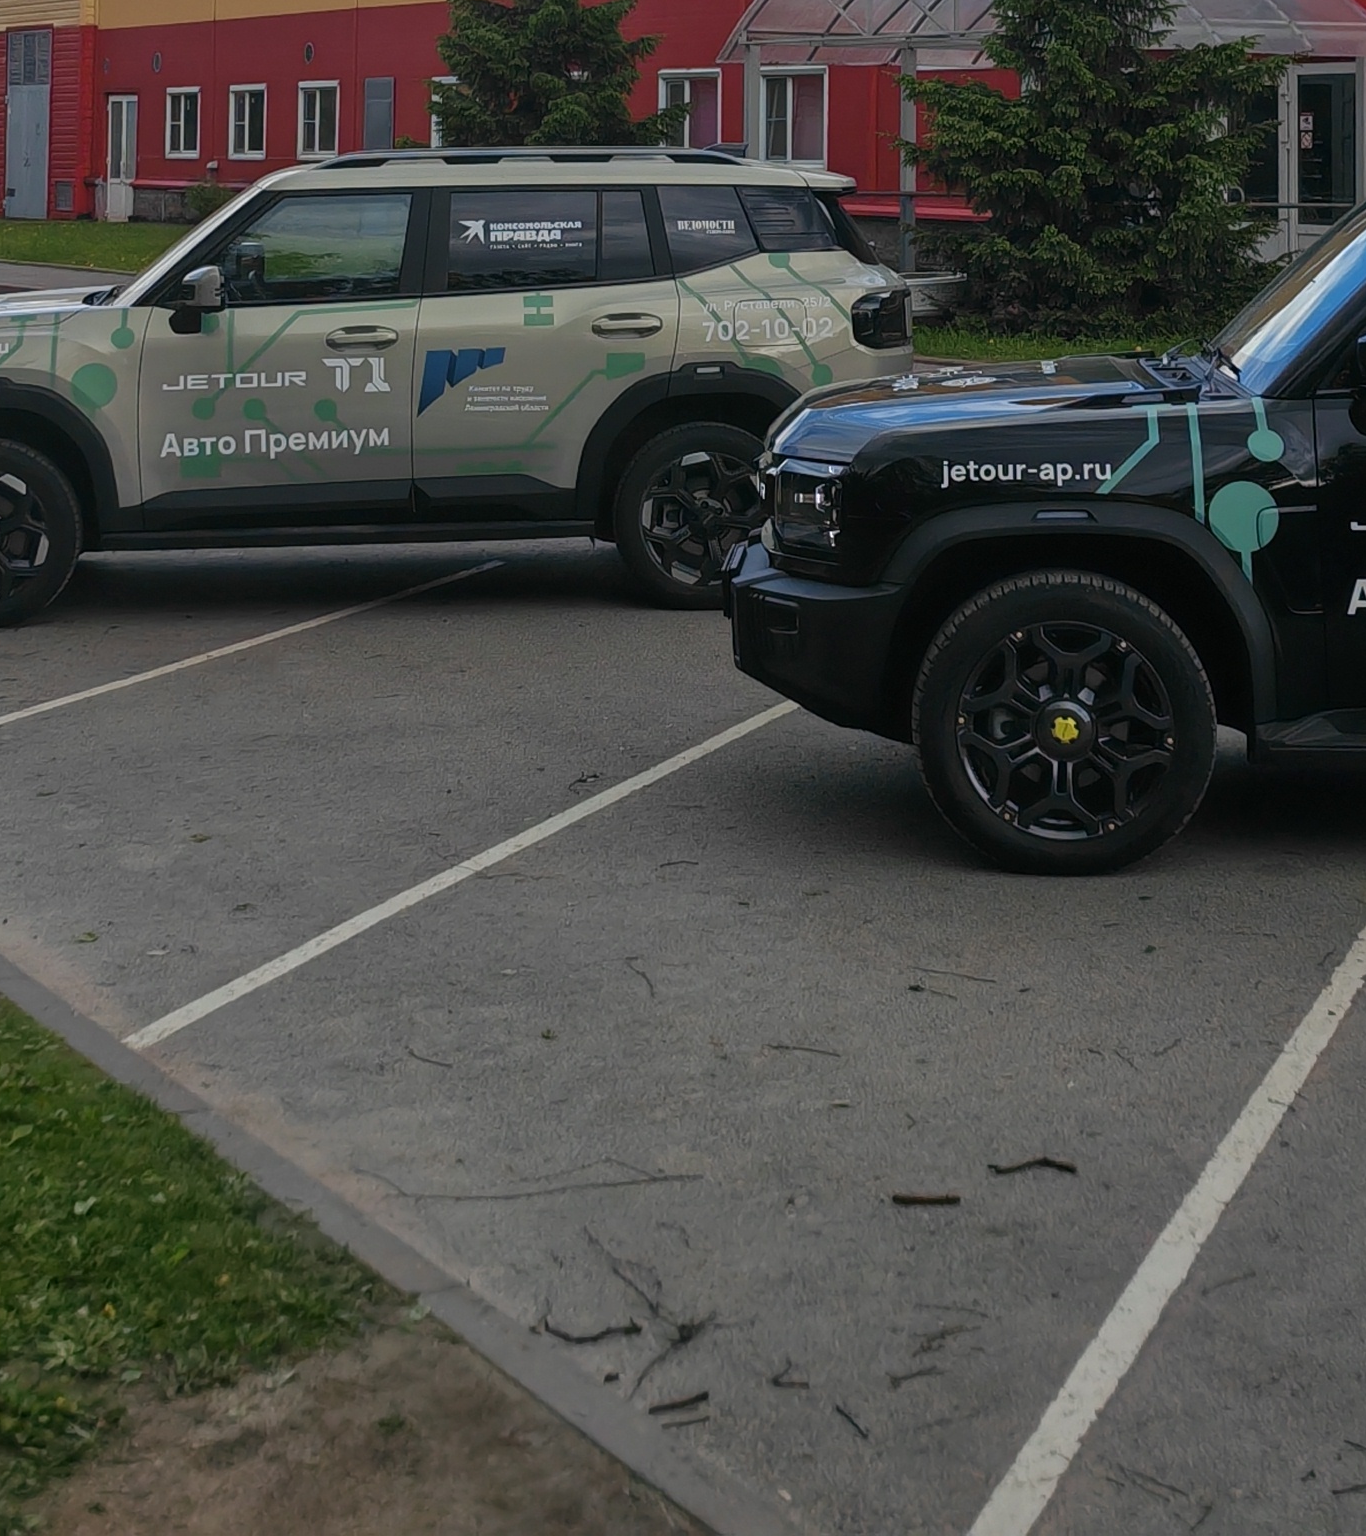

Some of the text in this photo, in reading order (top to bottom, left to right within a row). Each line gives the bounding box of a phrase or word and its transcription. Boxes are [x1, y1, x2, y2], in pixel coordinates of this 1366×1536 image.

[489, 221, 583, 231] КОМСОМОЛЬСКАЯ
[489, 230, 562, 242] ПРАВДА
[702, 317, 834, 342] 702-10-02
[162, 357, 391, 393] JETOUR T1
[160, 427, 390, 460] Авто Премиум
[941, 460, 1112, 489] jetour-ap.ru
